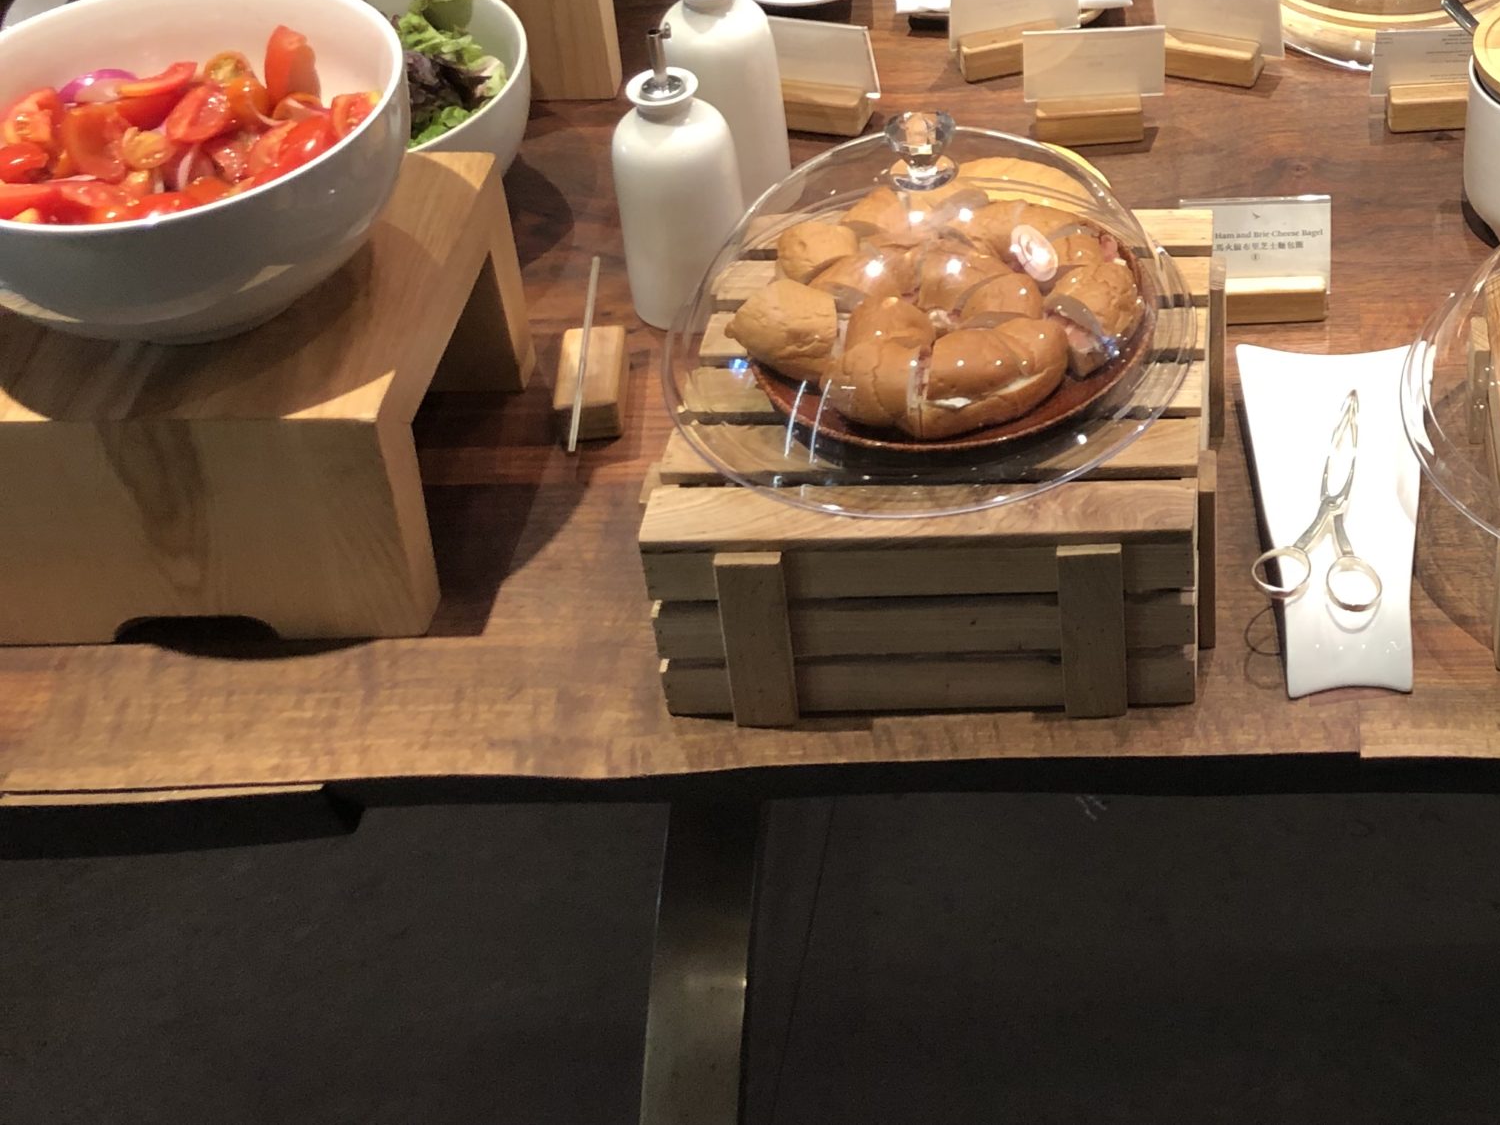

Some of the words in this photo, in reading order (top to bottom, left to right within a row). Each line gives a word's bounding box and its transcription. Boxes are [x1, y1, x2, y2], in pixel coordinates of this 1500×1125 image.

[1236, 230, 1251, 238] and
[1254, 230, 1269, 238] Brie
[1271, 229, 1299, 238] Cheese
[1302, 229, 1323, 238] Bagel
